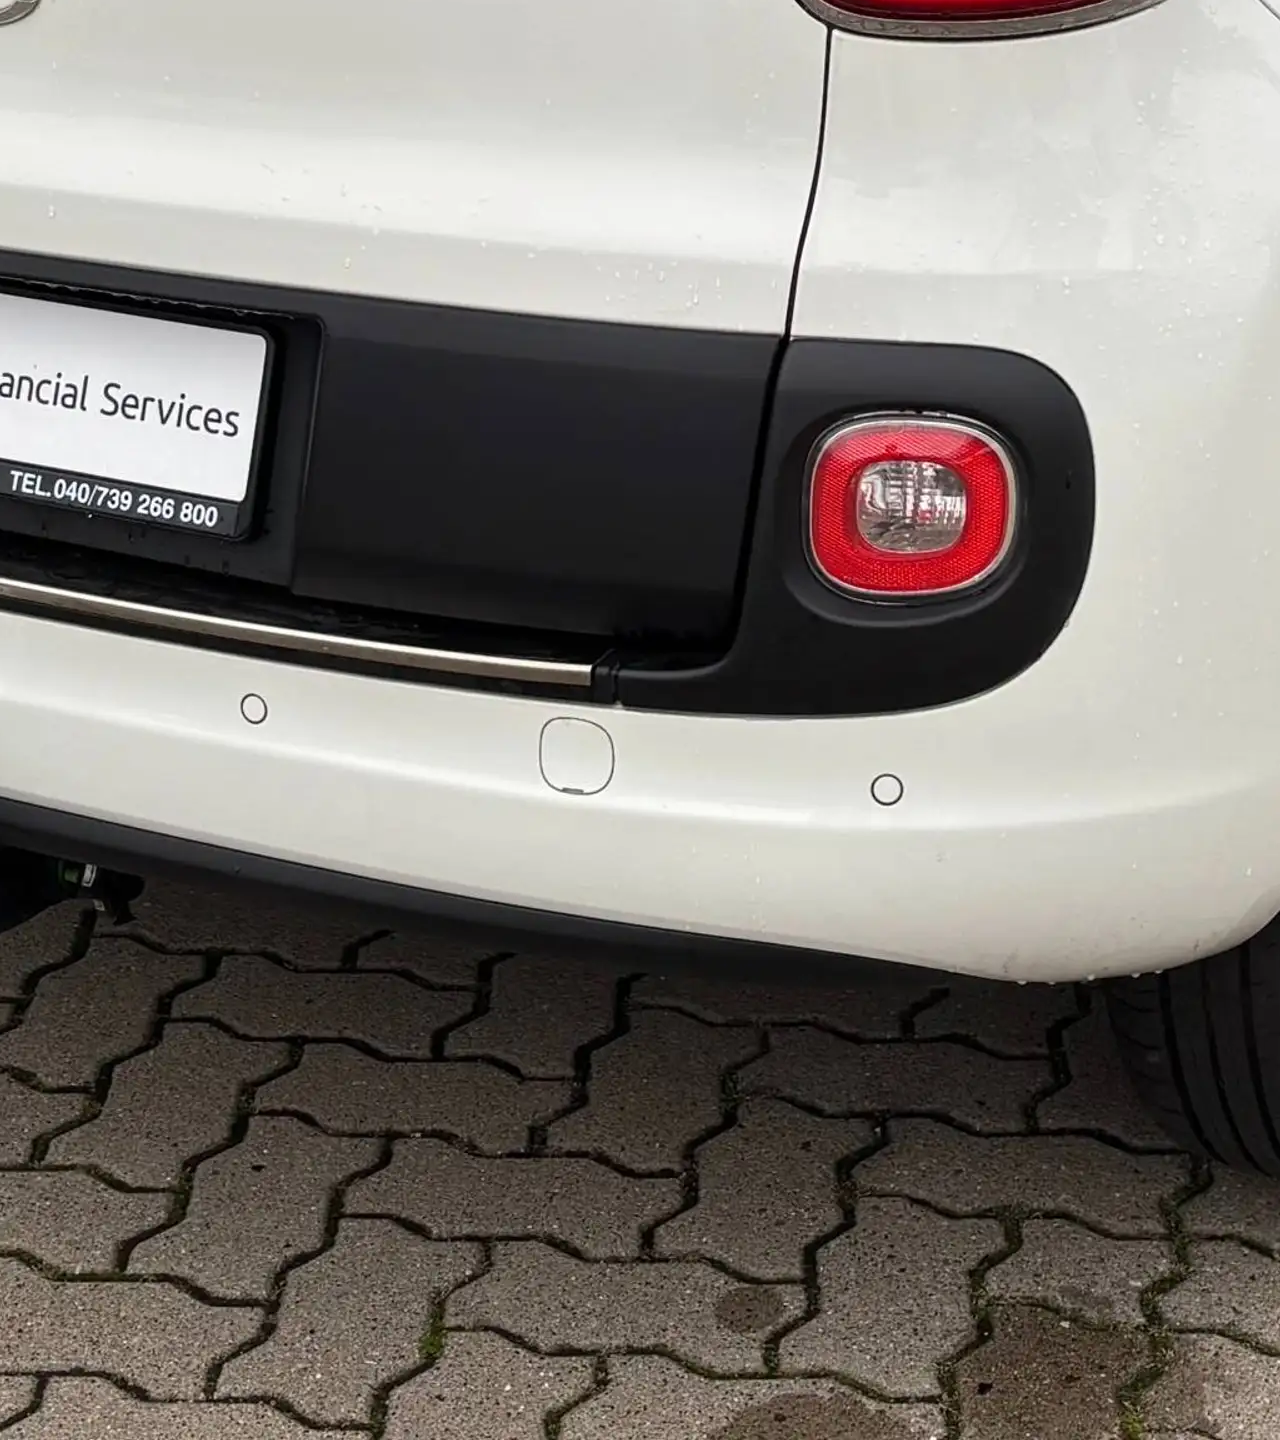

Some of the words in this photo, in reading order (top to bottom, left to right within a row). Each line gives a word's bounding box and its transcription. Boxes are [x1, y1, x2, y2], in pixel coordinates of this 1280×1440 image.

[99, 381, 240, 438] Services
[136, 493, 175, 520] 266
[179, 501, 218, 528] 800
